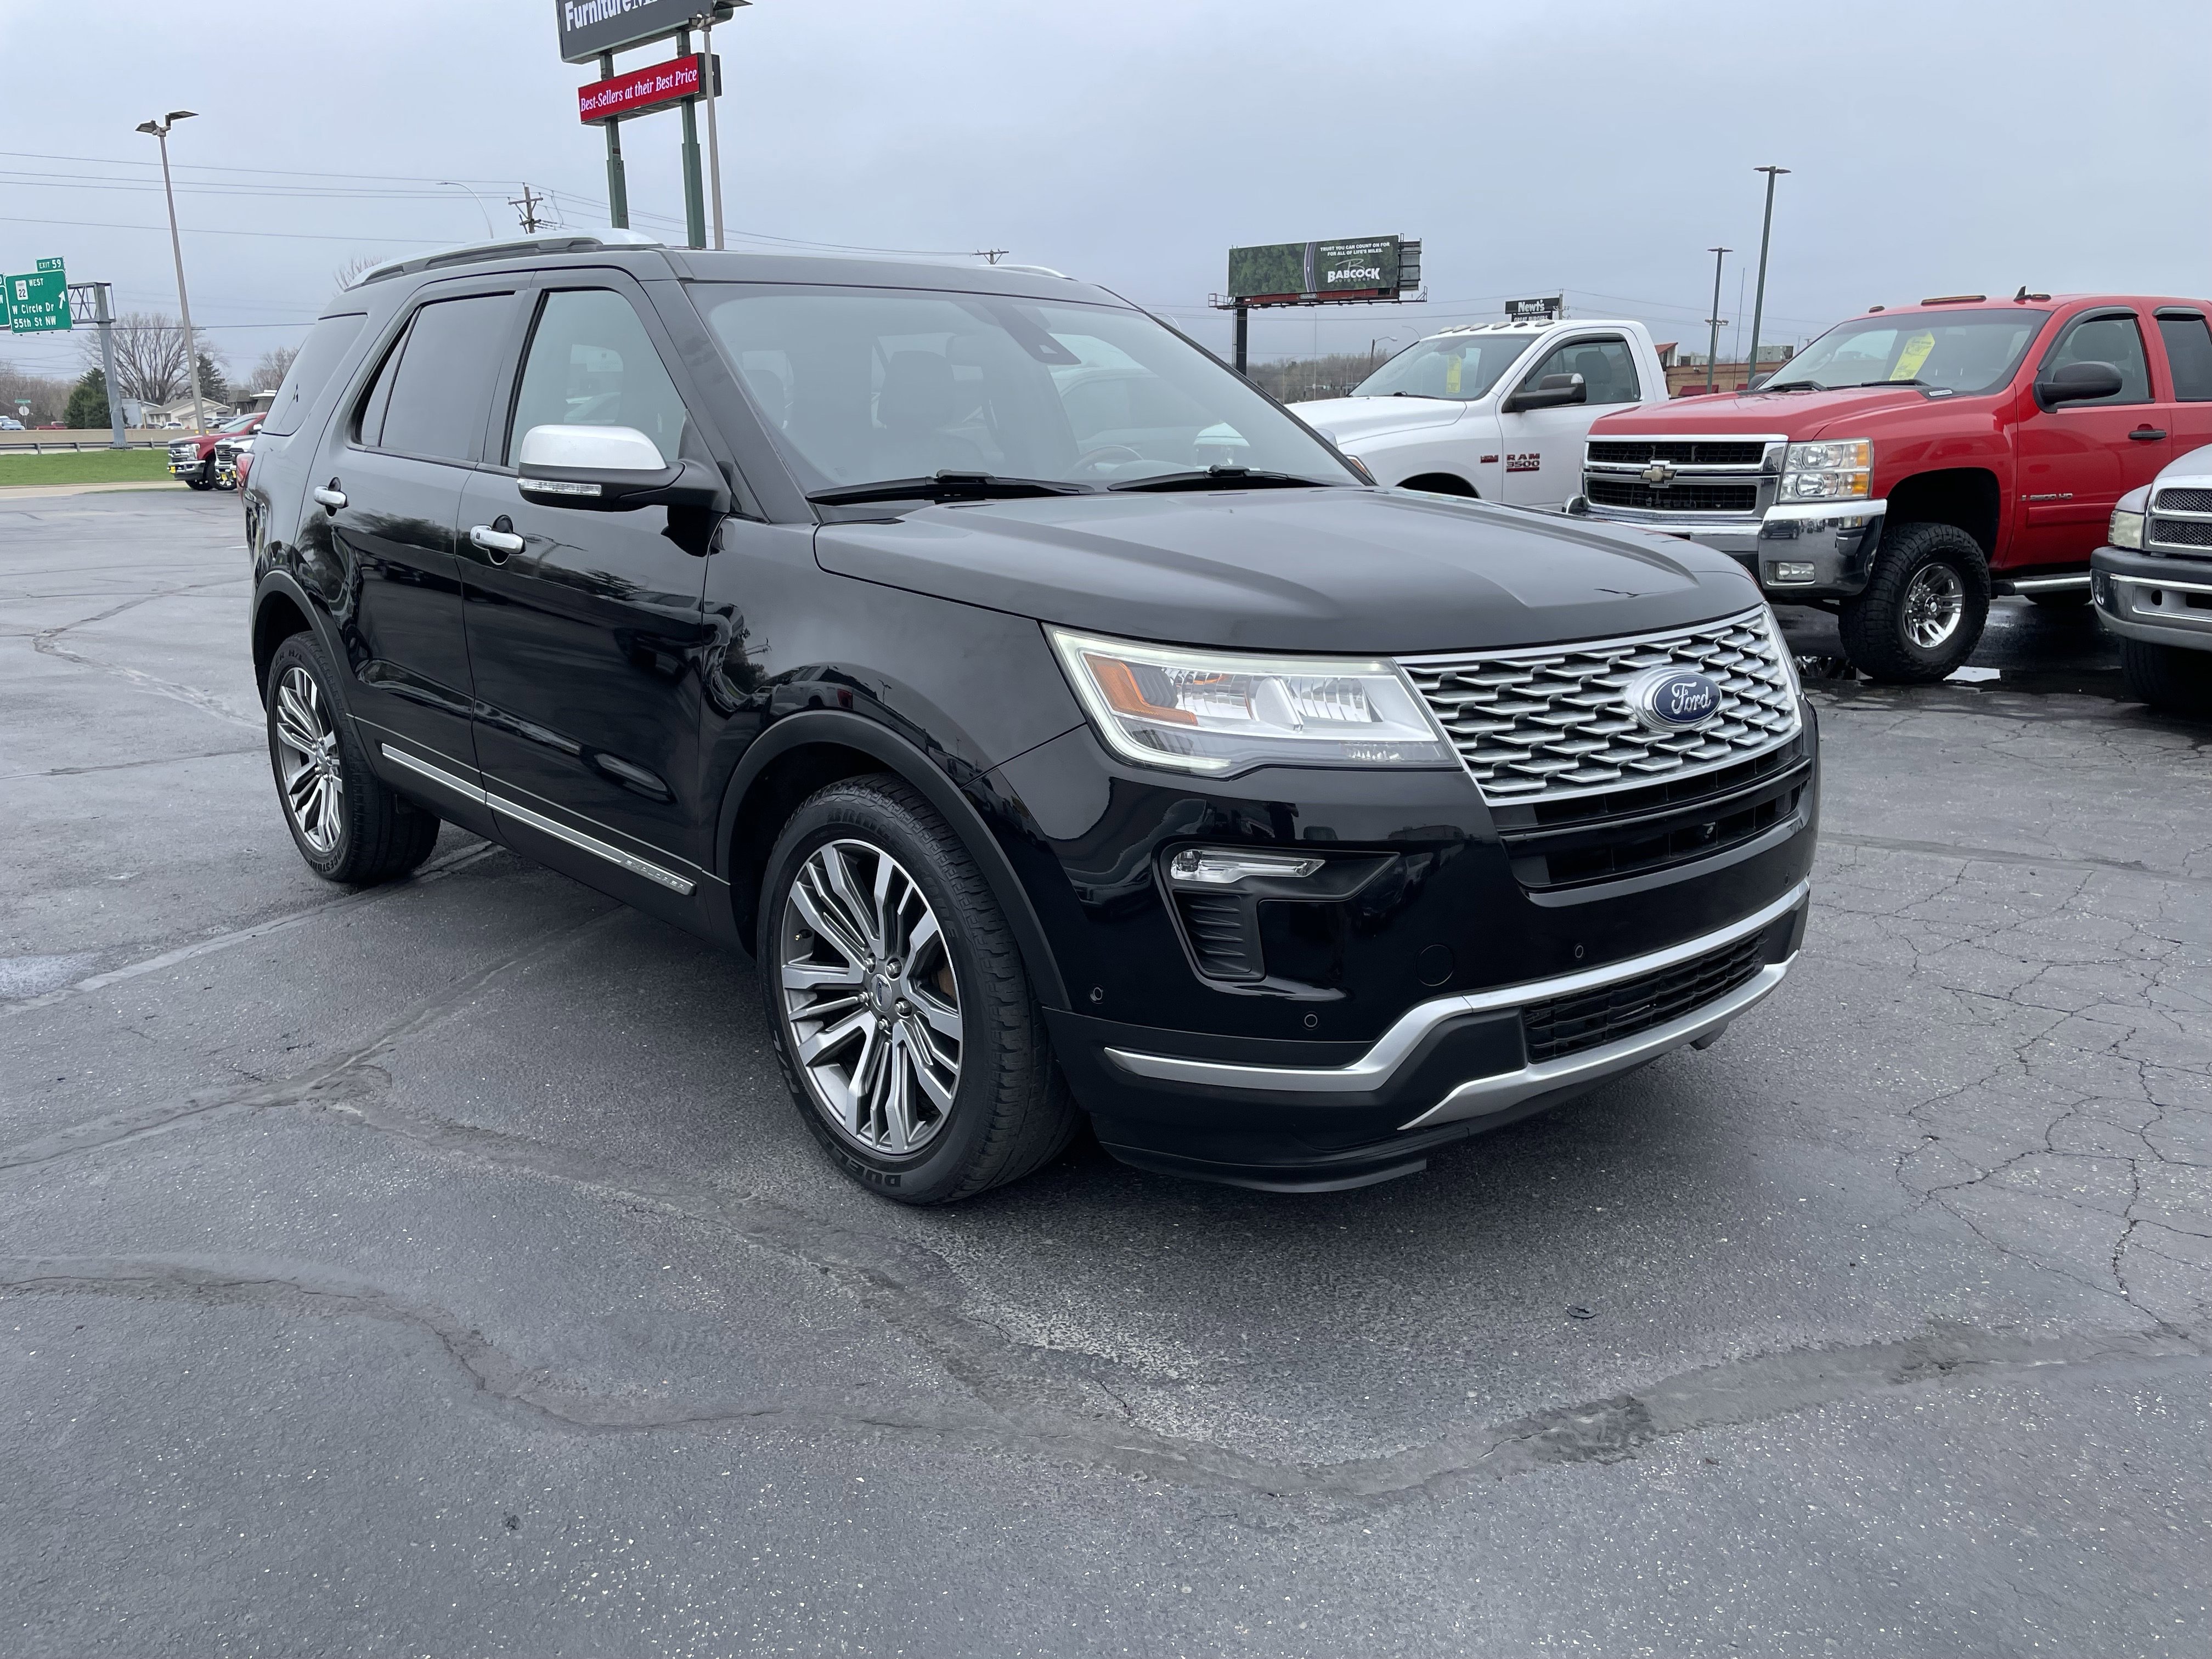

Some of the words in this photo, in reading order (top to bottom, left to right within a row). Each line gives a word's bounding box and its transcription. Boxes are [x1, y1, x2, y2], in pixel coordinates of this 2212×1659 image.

[580, 88, 623, 112] Best-Sellers
[625, 86, 633, 100] at
[635, 78, 654, 97] their
[656, 74, 673, 92] Best
[675, 67, 697, 87] Price
[52, 259, 61, 269] 59
[28, 278, 44, 287] WEST
[1327, 267, 1380, 284] BABCOCK
[18, 289, 26, 298] 22
[12, 305, 18, 315] W
[21, 303, 43, 314] Circle
[45, 302, 54, 312] Dr
[1517, 299, 1545, 313] Newt's
[14, 318, 32, 329] 55th
[34, 317, 43, 327] St
[45, 315, 56, 326] NW
[1671, 681, 1712, 714] Ford
[625, 859, 685, 891] EXPLORER
